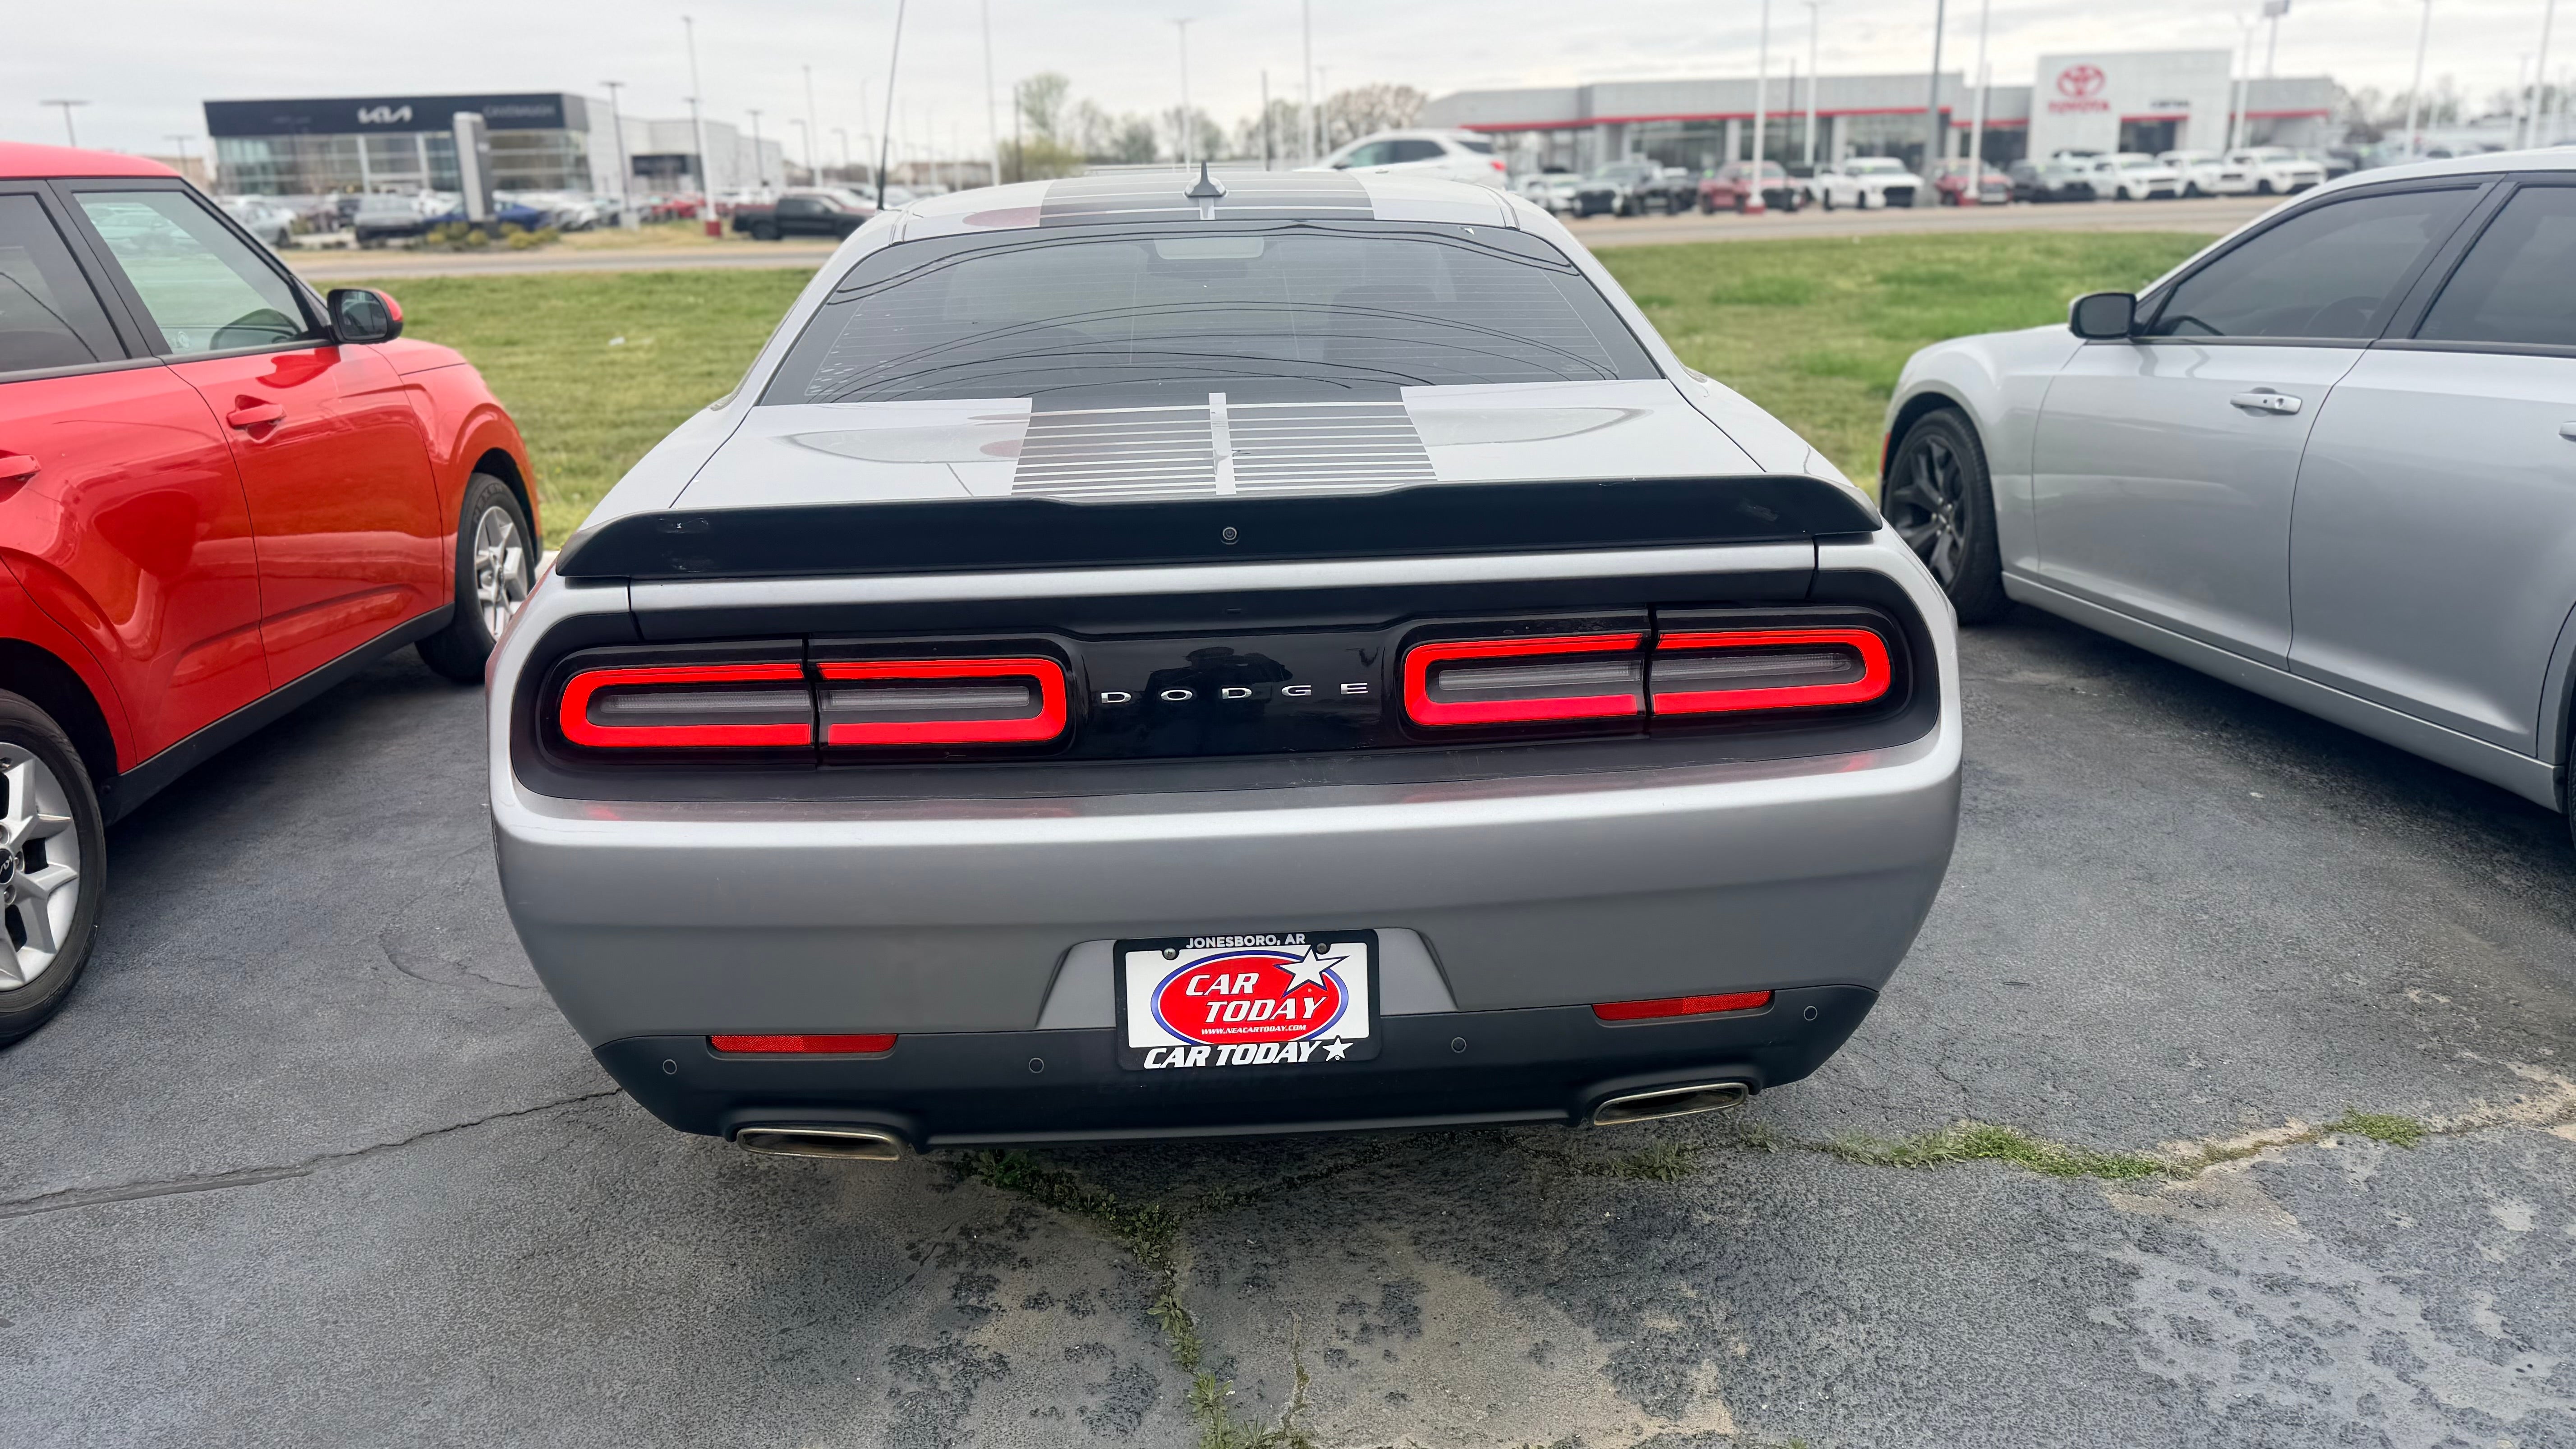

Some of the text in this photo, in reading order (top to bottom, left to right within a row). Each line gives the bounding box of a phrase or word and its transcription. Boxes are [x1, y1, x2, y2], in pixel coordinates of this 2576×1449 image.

[1101, 682, 1368, 704] DODGE
[1186, 933, 1306, 948] JONESBORO, AR
[1186, 972, 1259, 996] CAR
[1205, 996, 1328, 1023] TODAY
[1201, 1024, 1307, 1035] WWW.NEACARTODAY.COM
[1144, 1041, 1322, 1069] CAR TODAY
